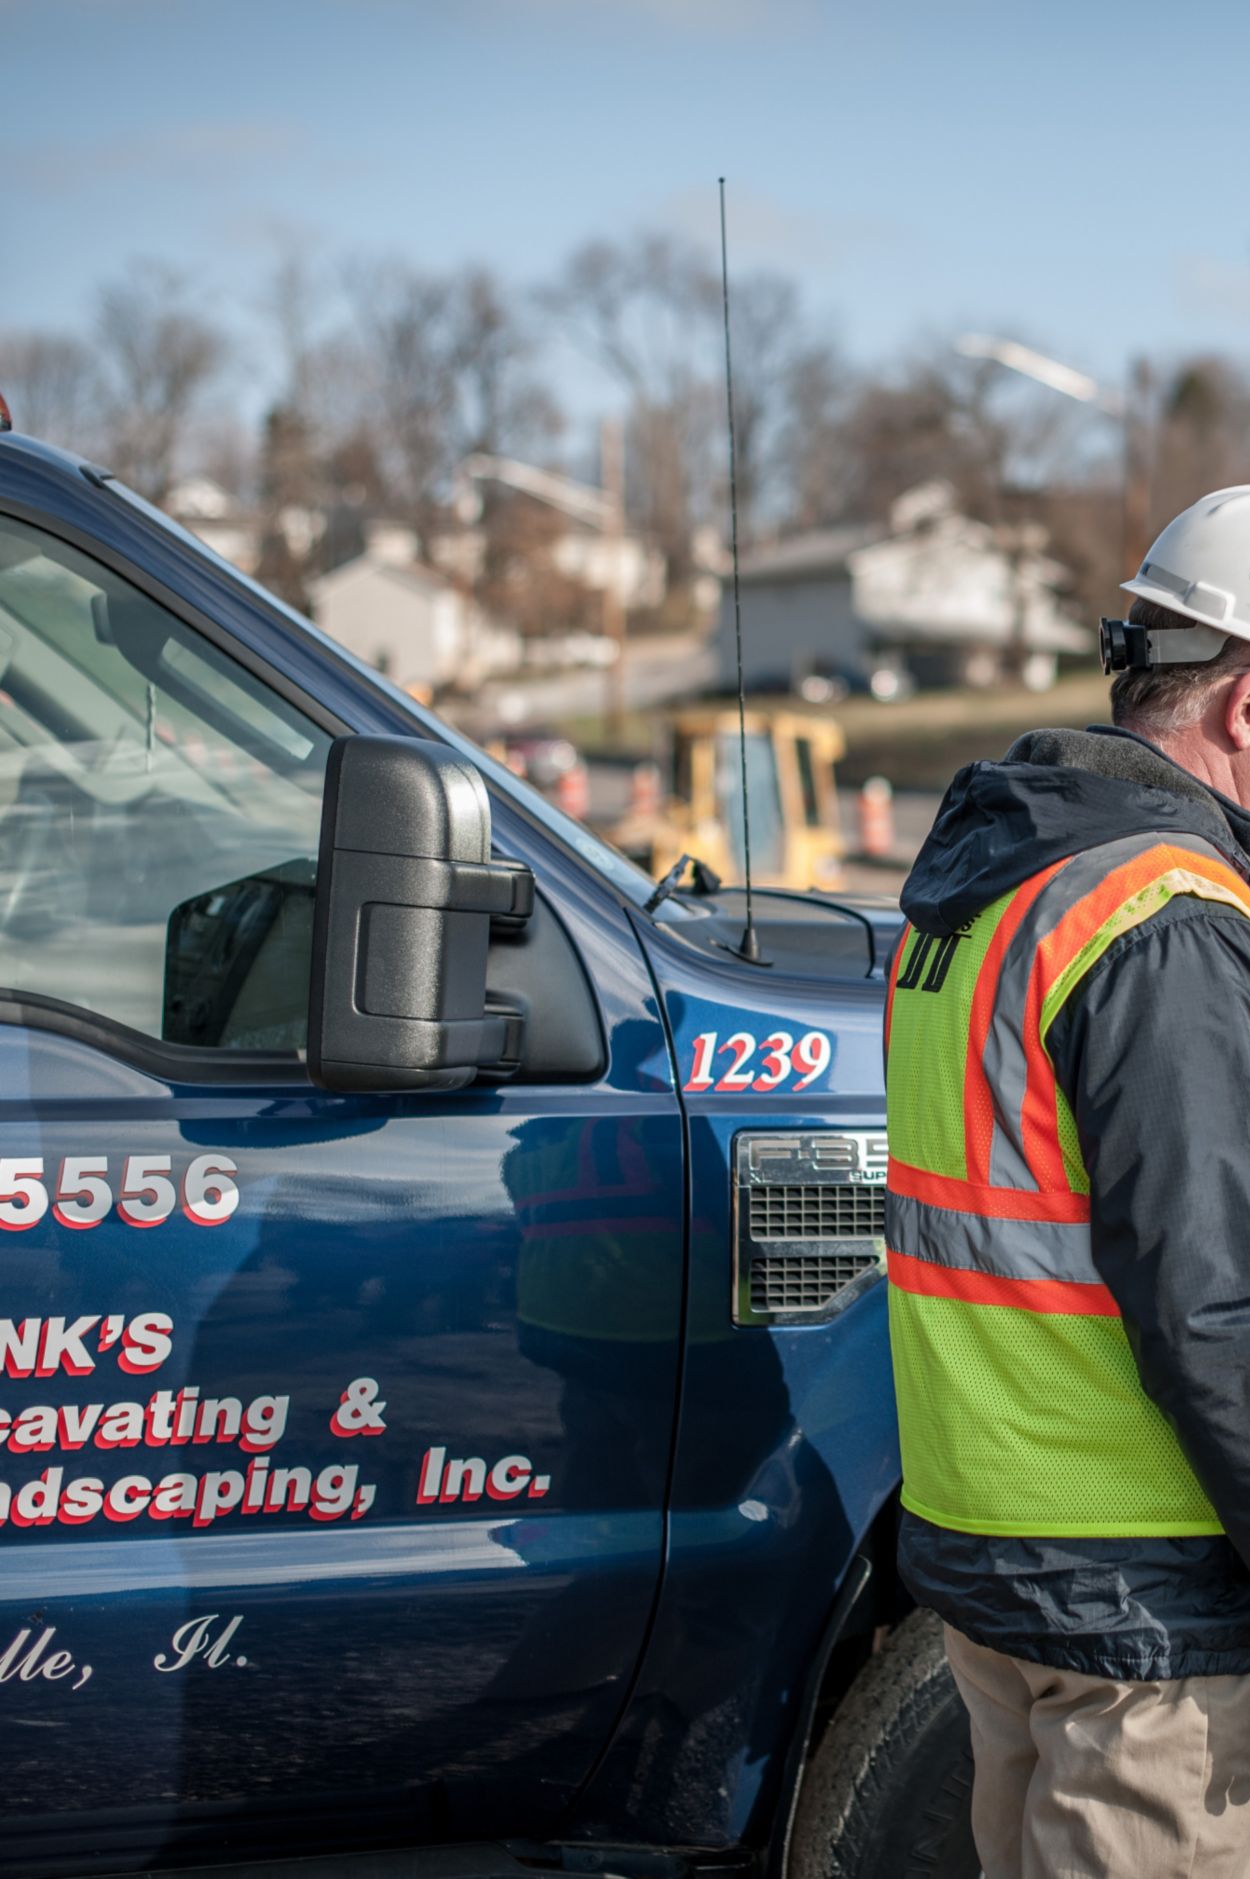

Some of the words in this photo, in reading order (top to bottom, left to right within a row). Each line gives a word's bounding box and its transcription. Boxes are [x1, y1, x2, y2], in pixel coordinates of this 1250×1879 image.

[682, 1031, 831, 1092] 1239
[0, 1154, 240, 1231] 5556
[0, 1312, 173, 1378] NK'S
[330, 1377, 387, 1437] &
[0, 1456, 377, 1528] dscaping,
[416, 1446, 551, 1505] Inc.
[154, 1614, 248, 1673] Il.
